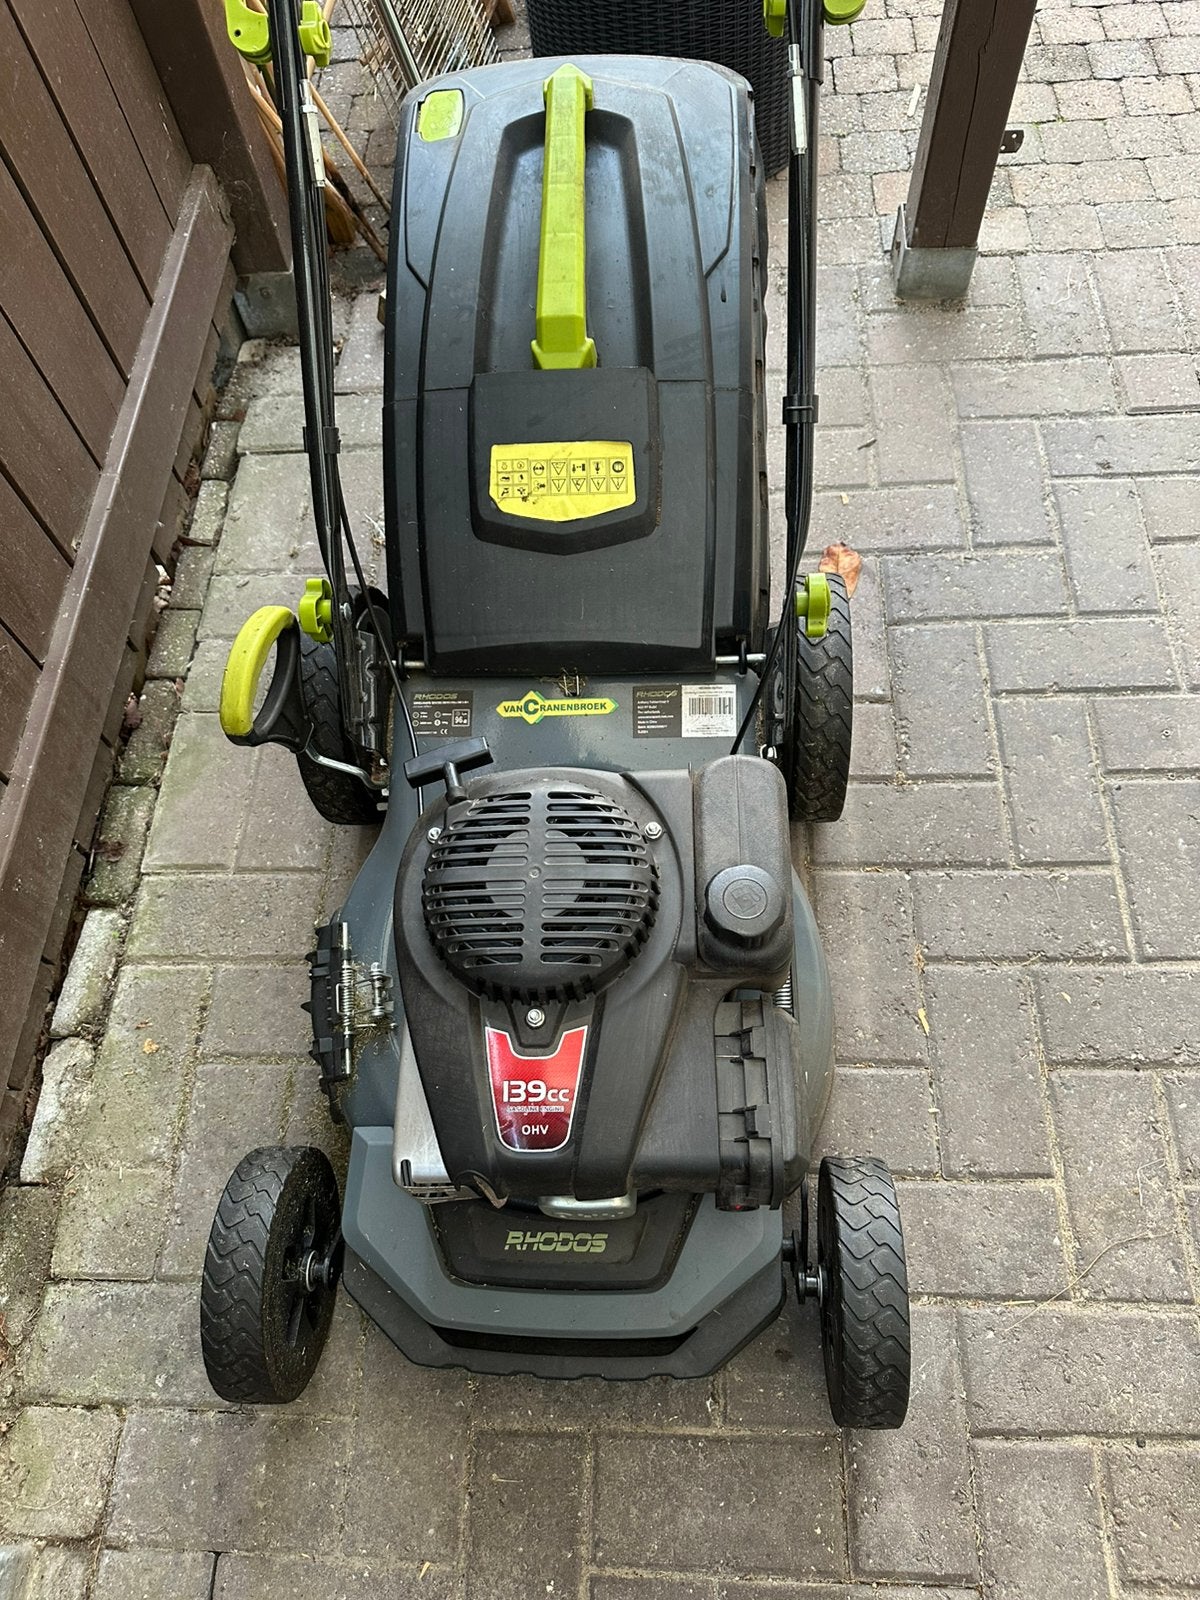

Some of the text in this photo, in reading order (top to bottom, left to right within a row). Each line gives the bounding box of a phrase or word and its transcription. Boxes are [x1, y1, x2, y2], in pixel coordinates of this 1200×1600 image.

[502, 1080, 569, 1102] 139cc
[521, 1125, 549, 1135] OHV
[504, 1231, 609, 1253] RHODOS
